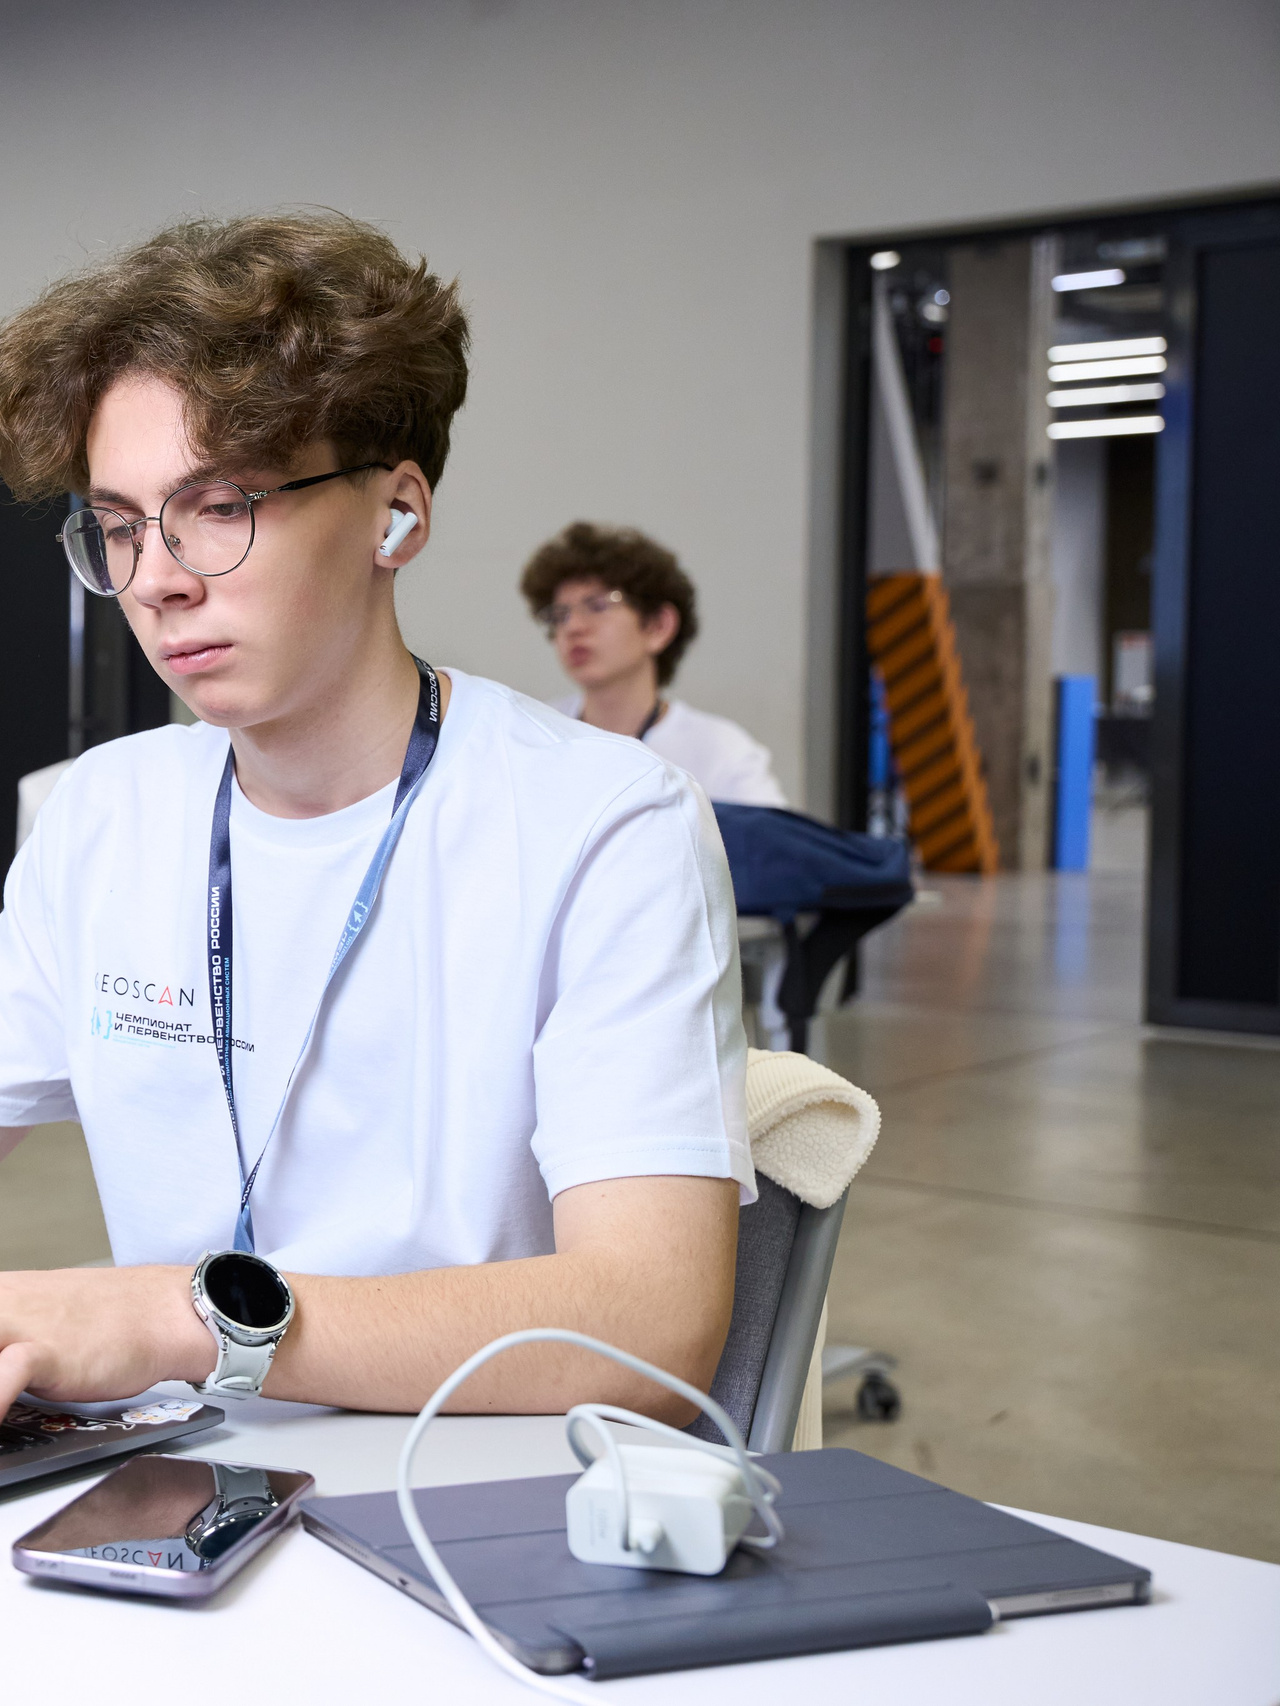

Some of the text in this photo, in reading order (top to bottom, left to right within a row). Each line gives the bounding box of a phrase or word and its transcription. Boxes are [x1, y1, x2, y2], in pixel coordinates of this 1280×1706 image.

[427, 671, 438, 722] РОССИИ
[211, 886, 220, 949] РОССИИ
[116, 1011, 192, 1032] ЧЕМПИОНАТ
[212, 954, 224, 1060] ПЕРВЕНСТВО
[114, 1022, 123, 1032] И
[127, 1025, 216, 1045] ПЕРВЕНСТВО
[231, 1038, 255, 1053] ОССИИ
